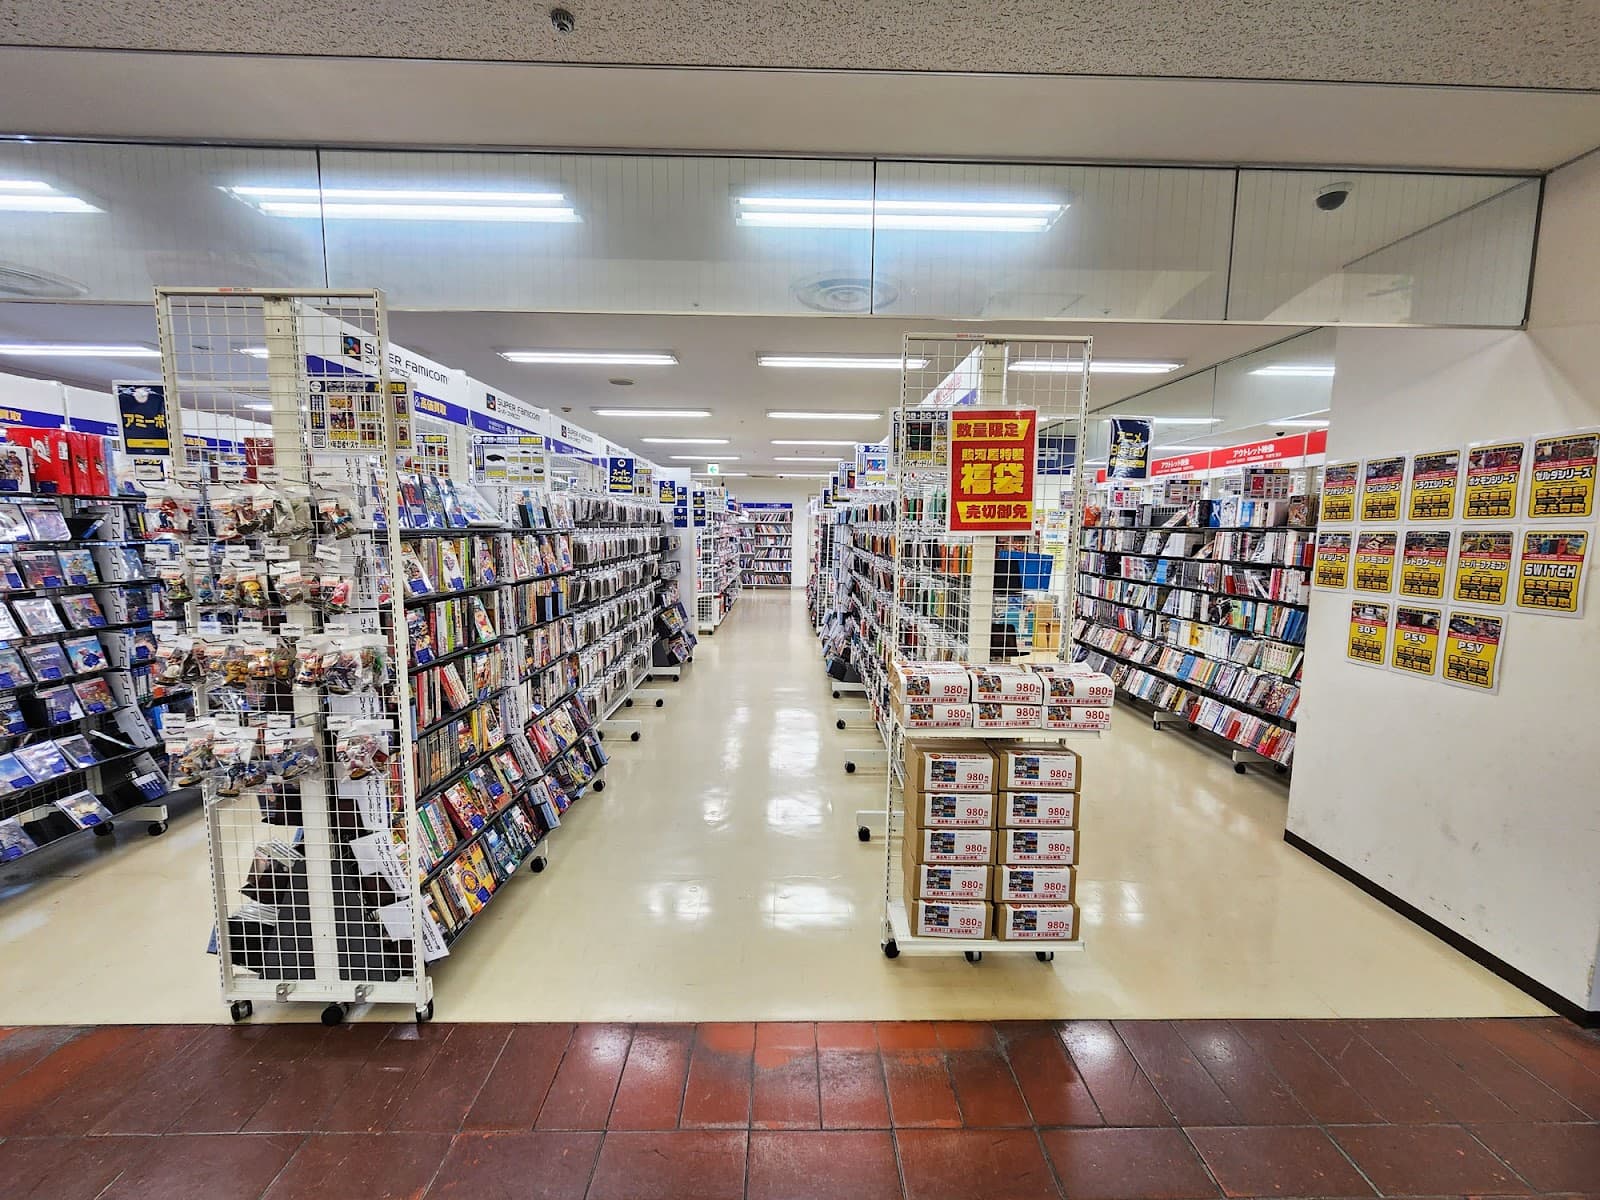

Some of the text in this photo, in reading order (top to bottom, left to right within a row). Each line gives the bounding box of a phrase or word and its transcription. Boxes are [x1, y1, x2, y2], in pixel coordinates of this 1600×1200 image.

[957, 422, 1019, 438] 数量限定
[960, 463, 1024, 494] 福袋
[966, 504, 1028, 519] 売切御免
[1524, 563, 1577, 578] SWITCH
[1404, 632, 1427, 643] PS4
[119, 636, 127, 668] PS4
[1458, 641, 1485, 653] PSV
[120, 673, 133, 704] PS4
[130, 711, 150, 740] PS4
